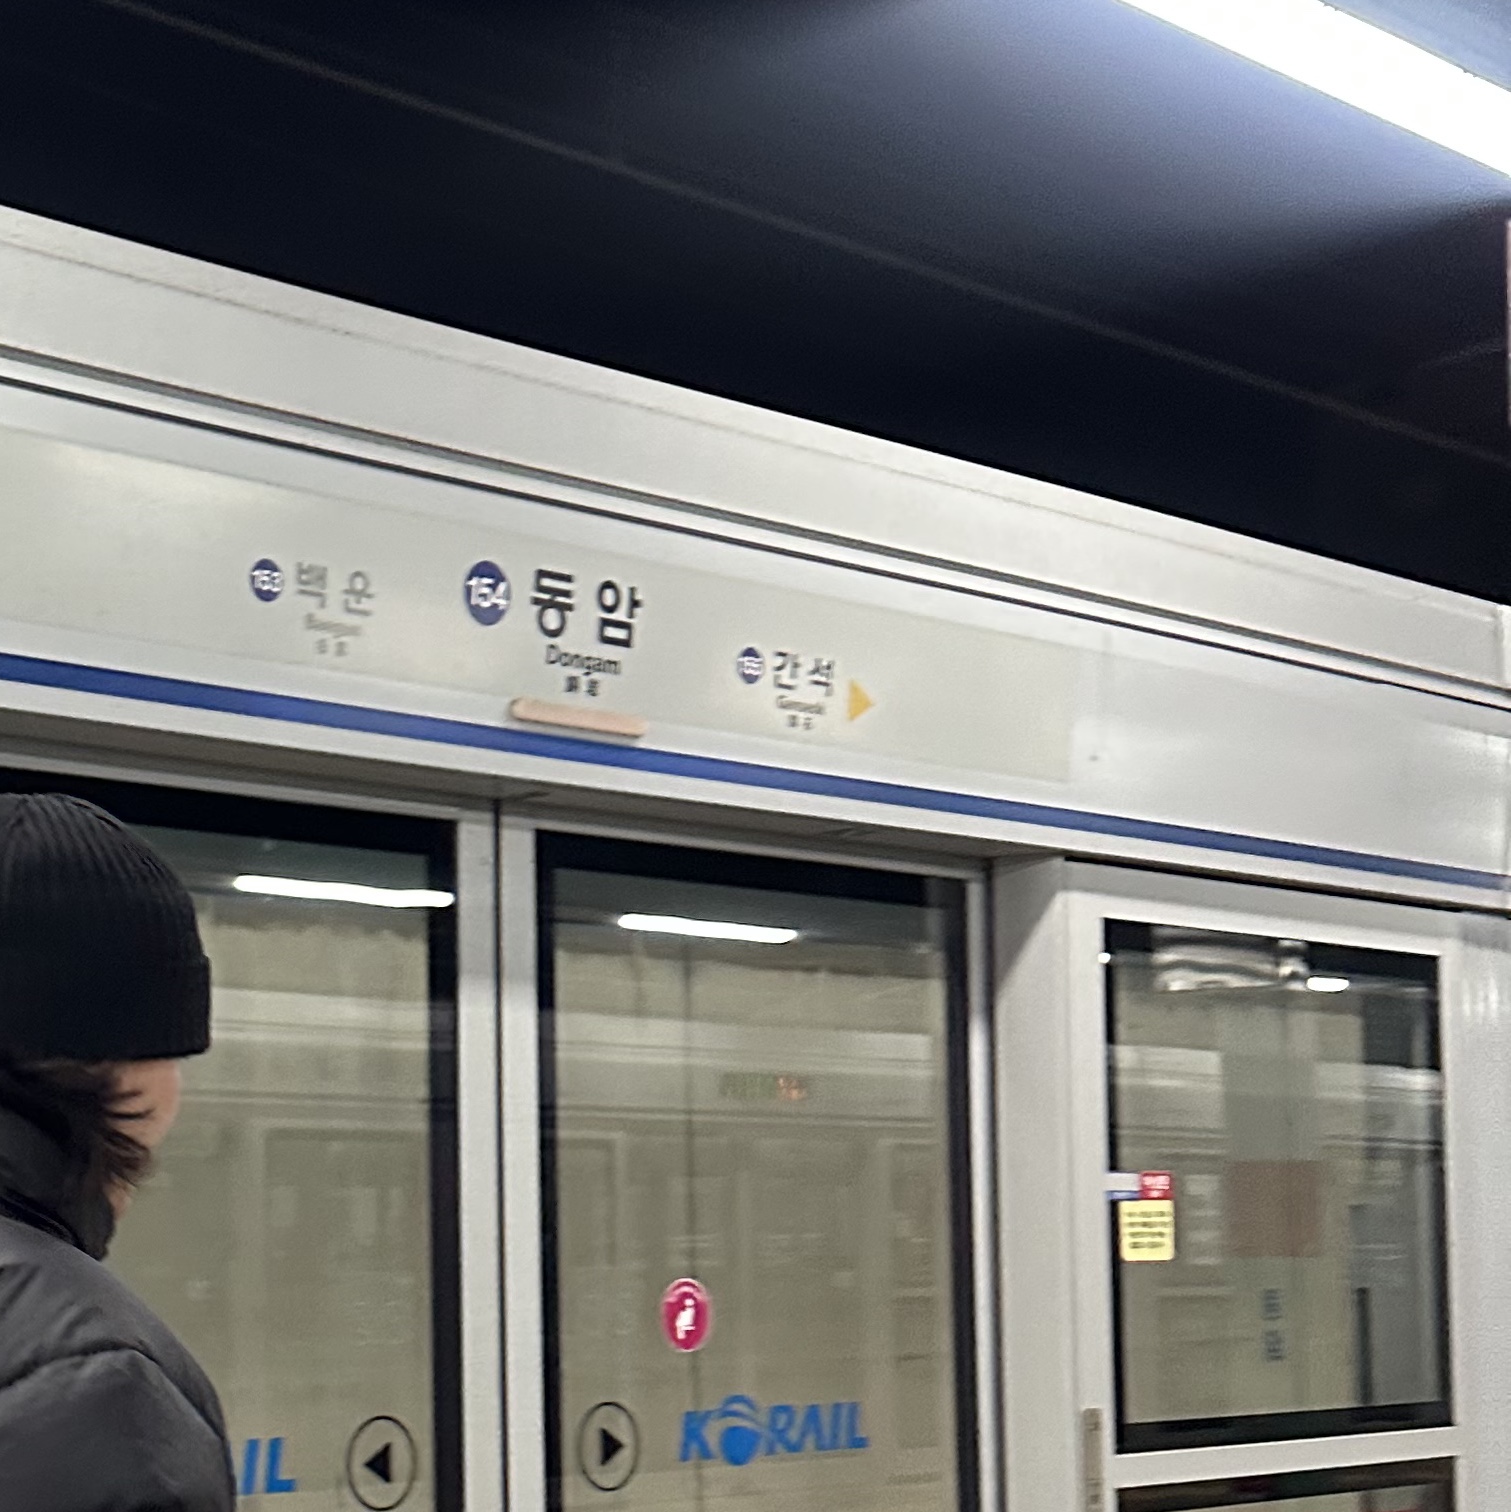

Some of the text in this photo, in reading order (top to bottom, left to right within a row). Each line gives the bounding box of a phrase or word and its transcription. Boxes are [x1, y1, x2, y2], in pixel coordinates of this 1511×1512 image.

[465, 575, 508, 610] 154
[530, 568, 644, 649] 동암
[545, 642, 622, 676] Dongam
[773, 650, 835, 698] 간석
[678, 1394, 870, 1467] KORAIL
